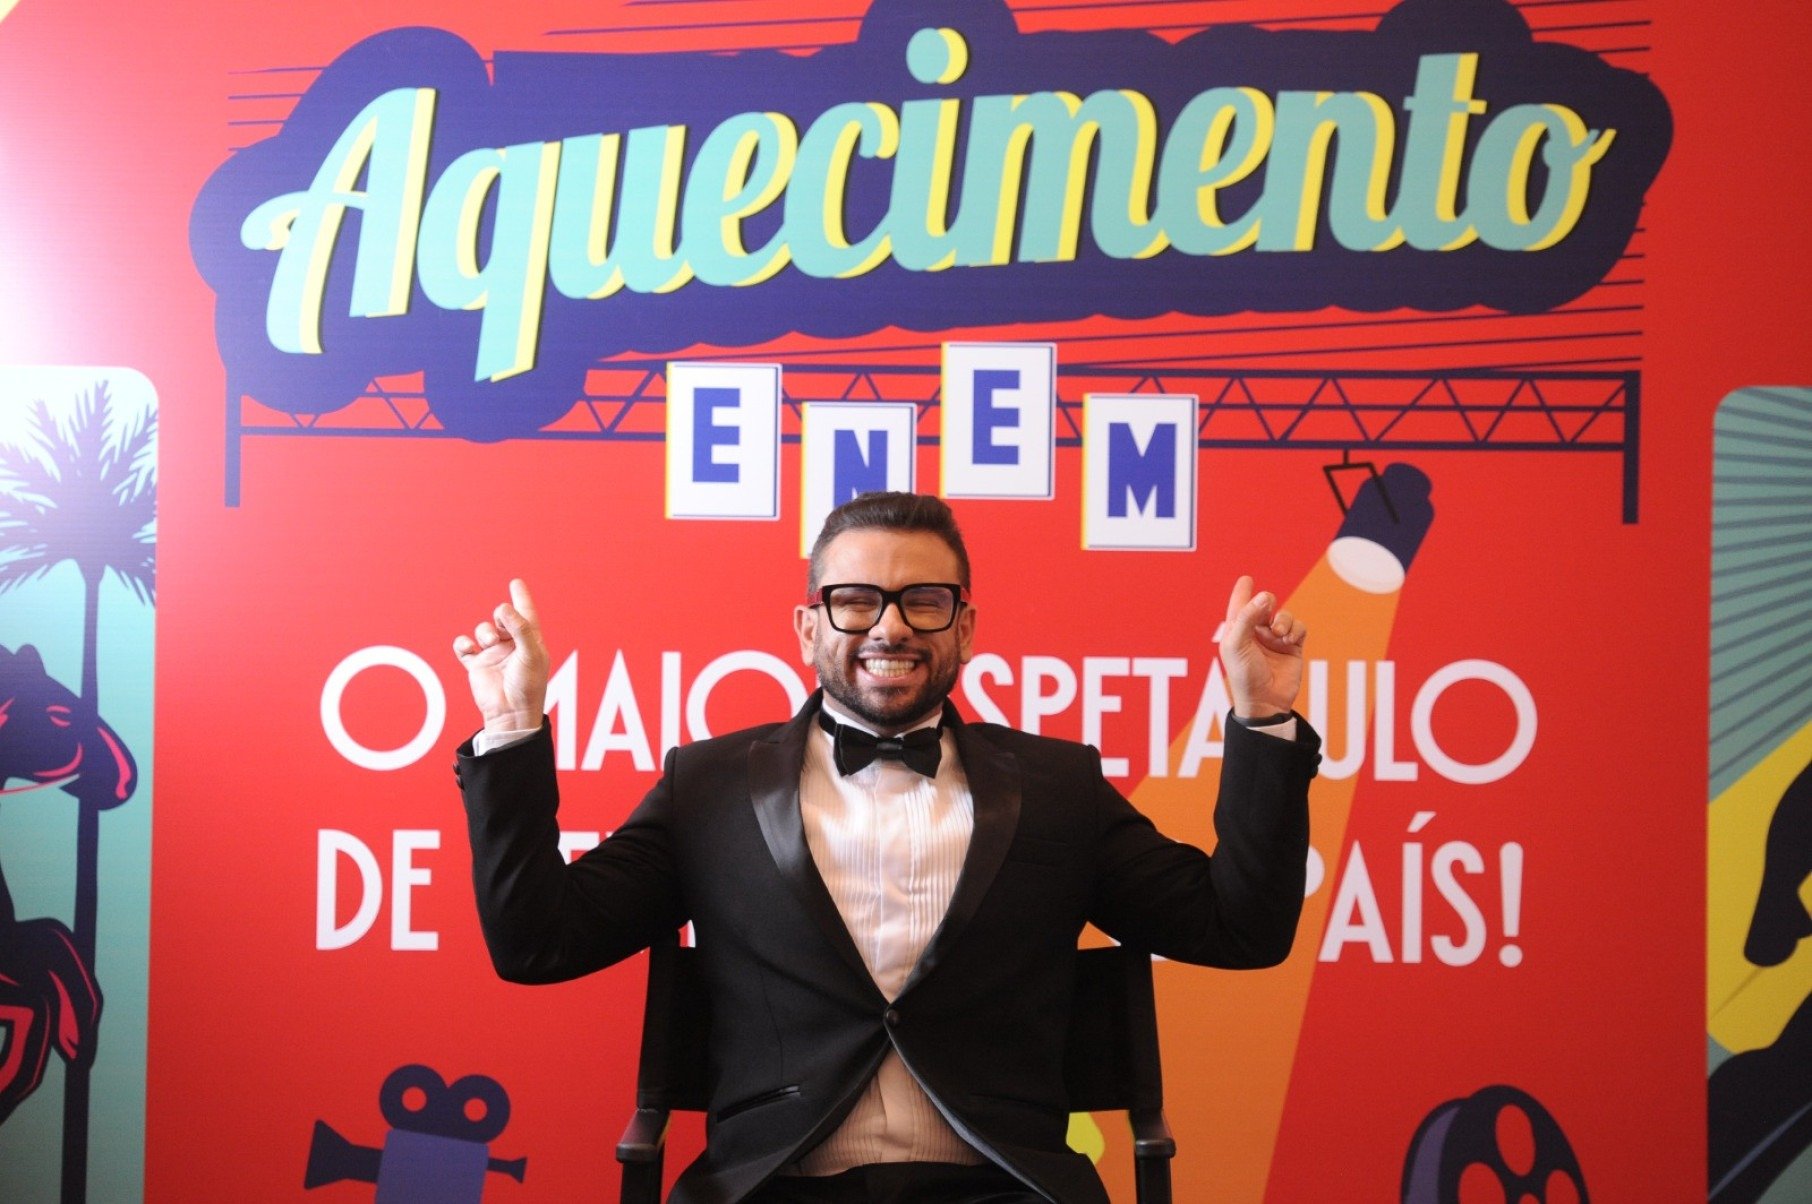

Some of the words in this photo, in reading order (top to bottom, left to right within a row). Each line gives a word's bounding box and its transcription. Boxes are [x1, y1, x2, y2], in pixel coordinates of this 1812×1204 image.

[241, 28, 1616, 382] Aquecimento
[320, 645, 447, 771] O
[316, 829, 441, 952] DE
[1304, 811, 1524, 968] AÍS!
